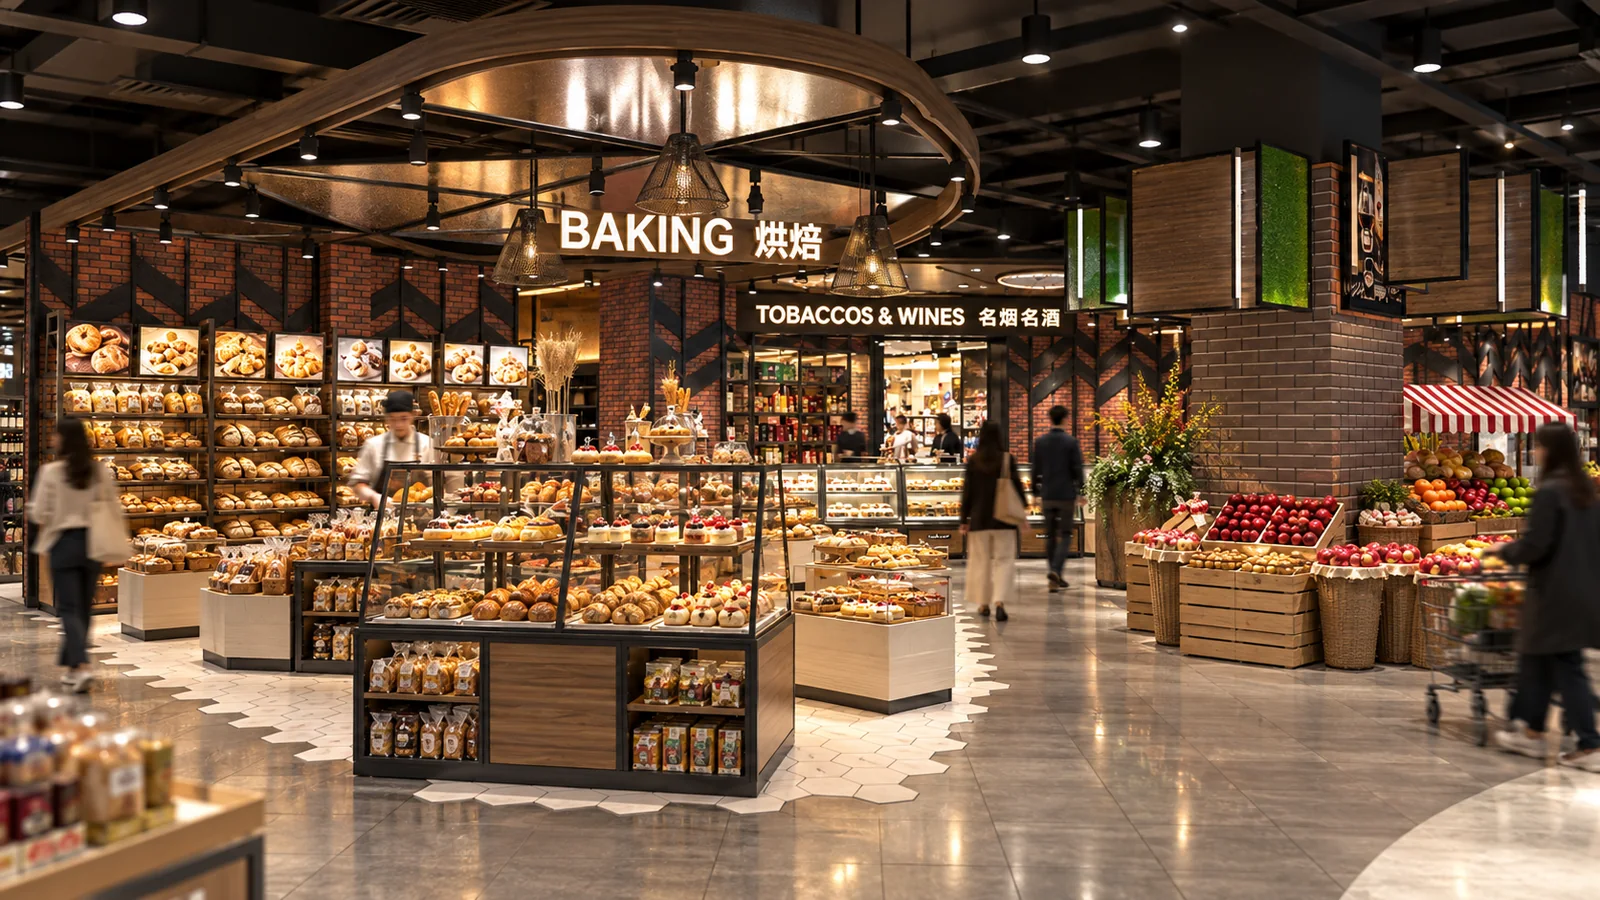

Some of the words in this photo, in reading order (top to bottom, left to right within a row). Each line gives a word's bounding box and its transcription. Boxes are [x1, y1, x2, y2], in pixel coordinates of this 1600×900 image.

[561, 210, 734, 256] BAKING
[754, 220, 823, 261] 烘焙
[757, 304, 874, 325] TOBACCOS
[878, 306, 894, 326] &
[897, 307, 965, 327] WINES
[978, 307, 1061, 328] 名烟名酒
